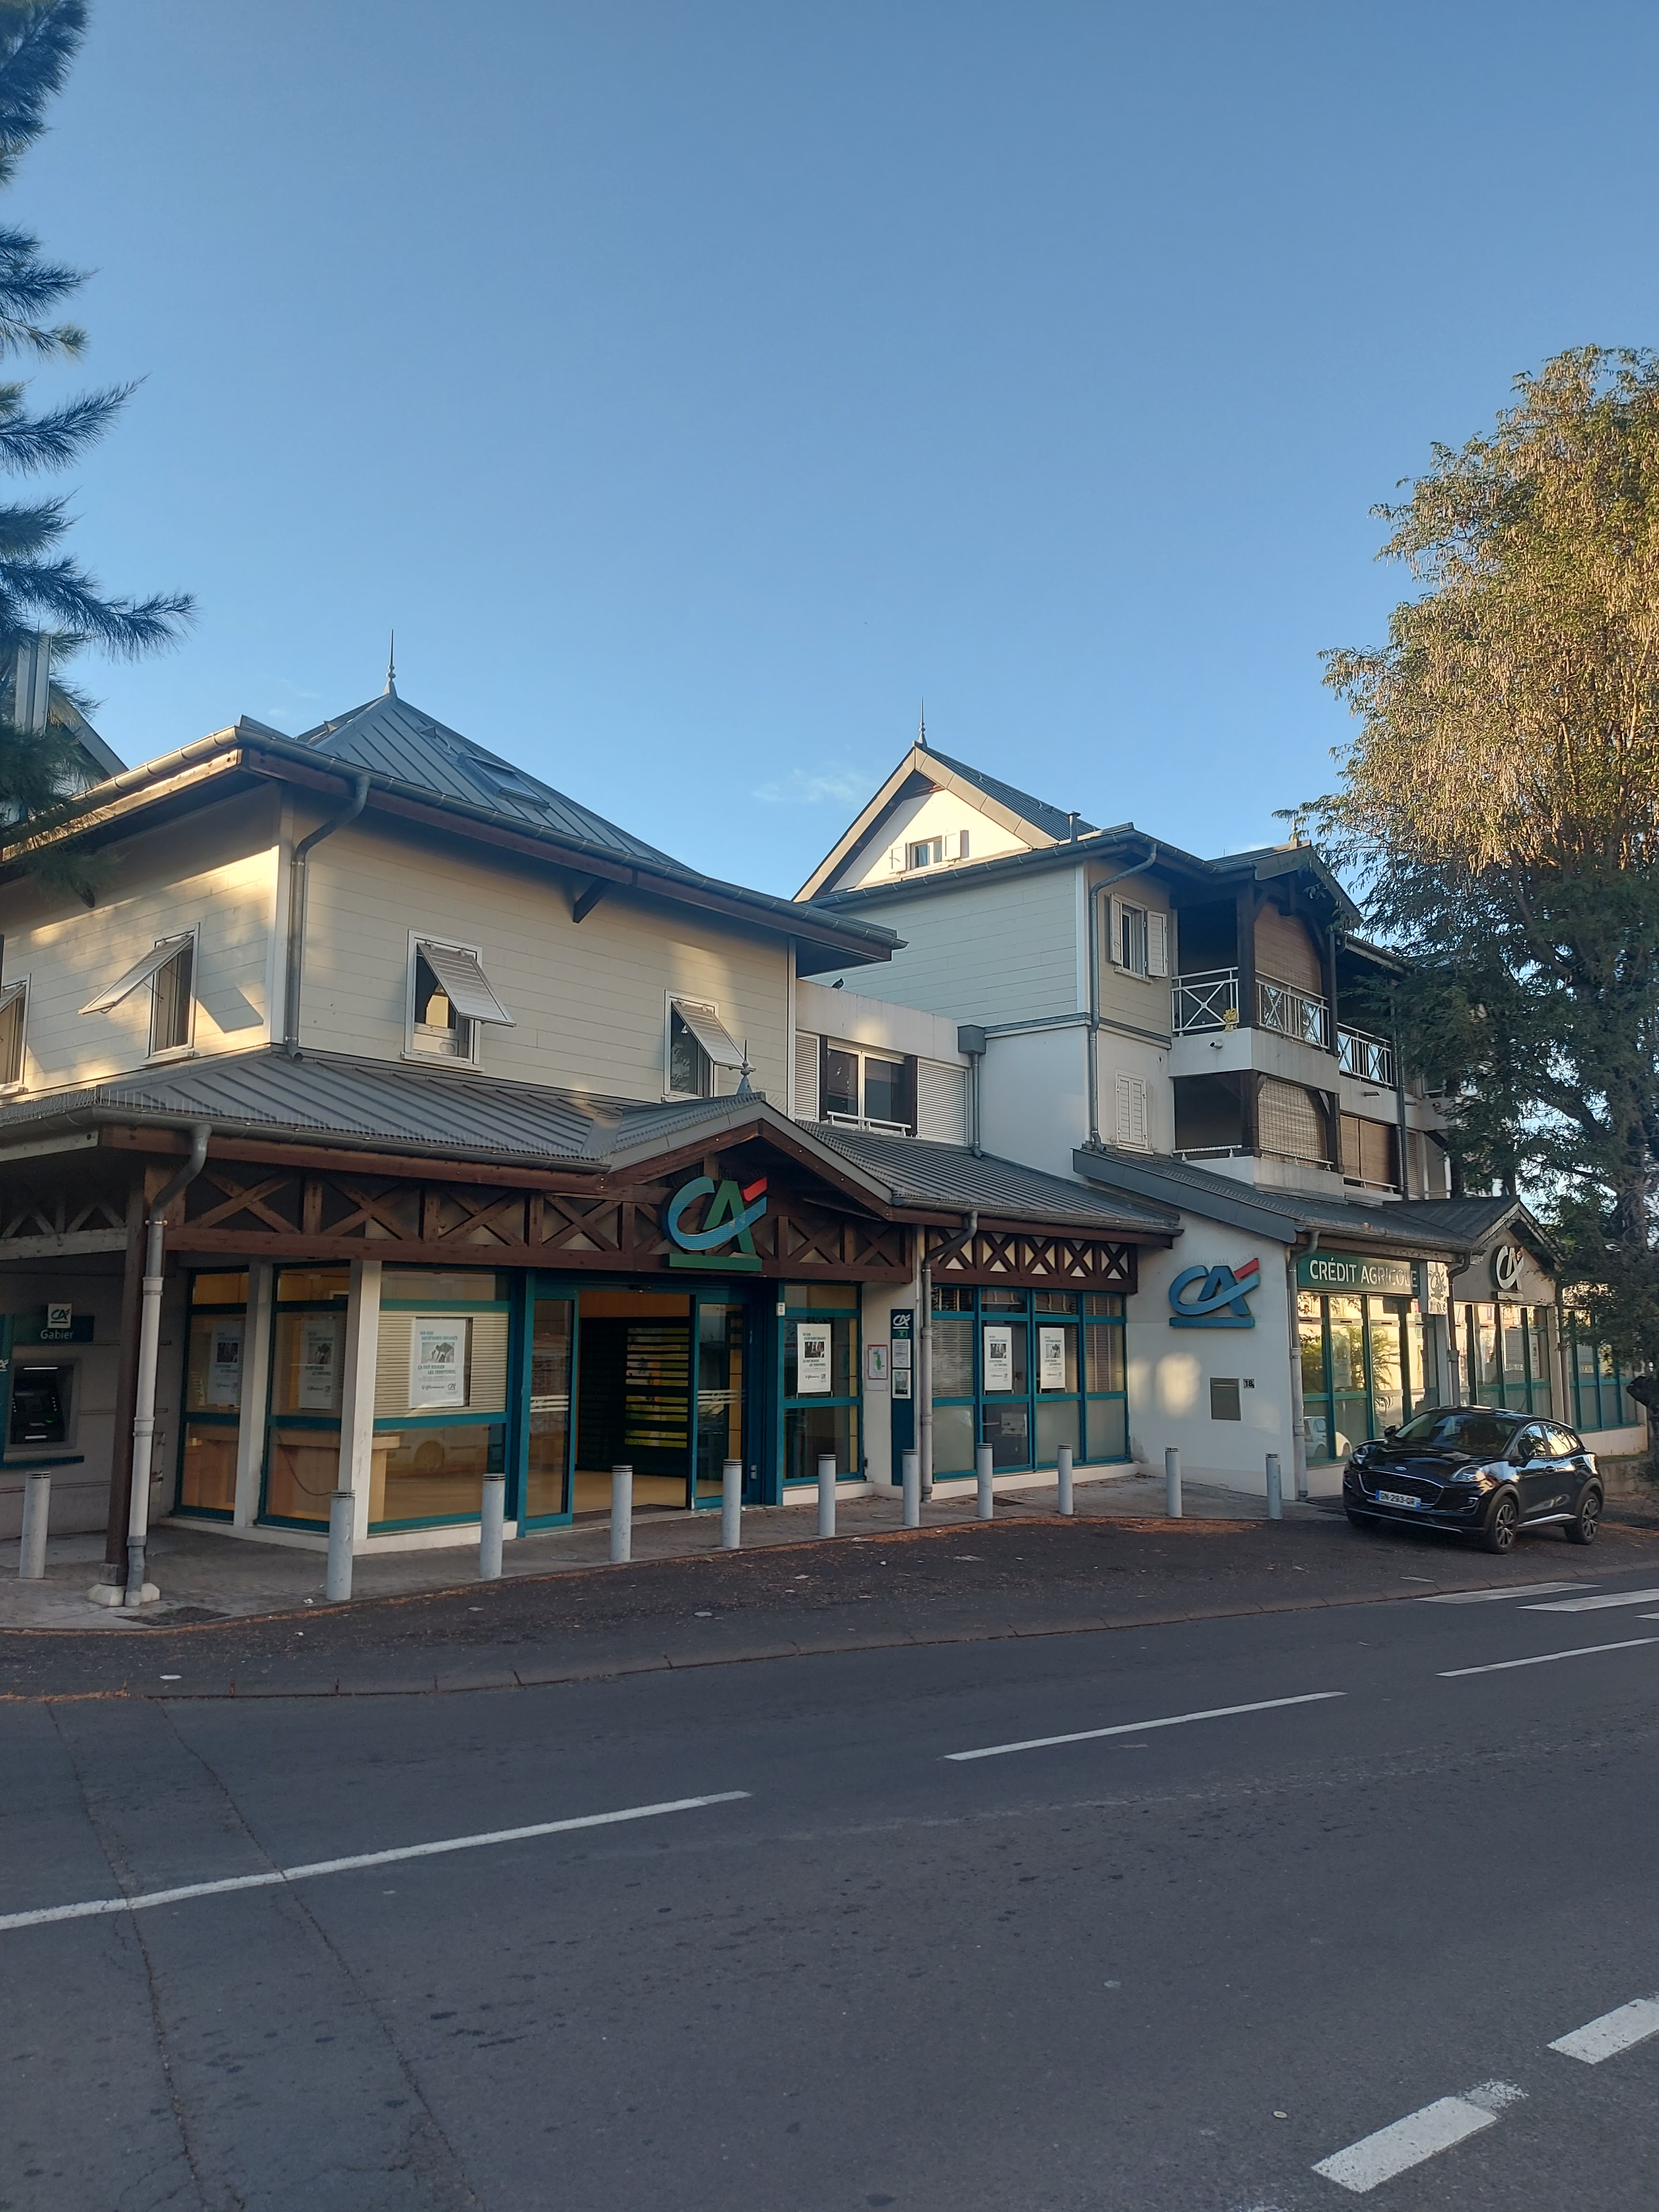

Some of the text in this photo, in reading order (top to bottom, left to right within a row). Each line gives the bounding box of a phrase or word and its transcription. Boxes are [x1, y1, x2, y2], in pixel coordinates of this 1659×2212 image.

[666, 1176, 767, 1255] CA
[1309, 1257, 1418, 1288] CRÉDIT AGRICOLE
[1495, 1245, 1524, 1291] CA
[1168, 1258, 1261, 1316] CA
[51, 1308, 70, 1320] CA
[893, 1314, 911, 1327] CA
[40, 1329, 73, 1339] Gabier
